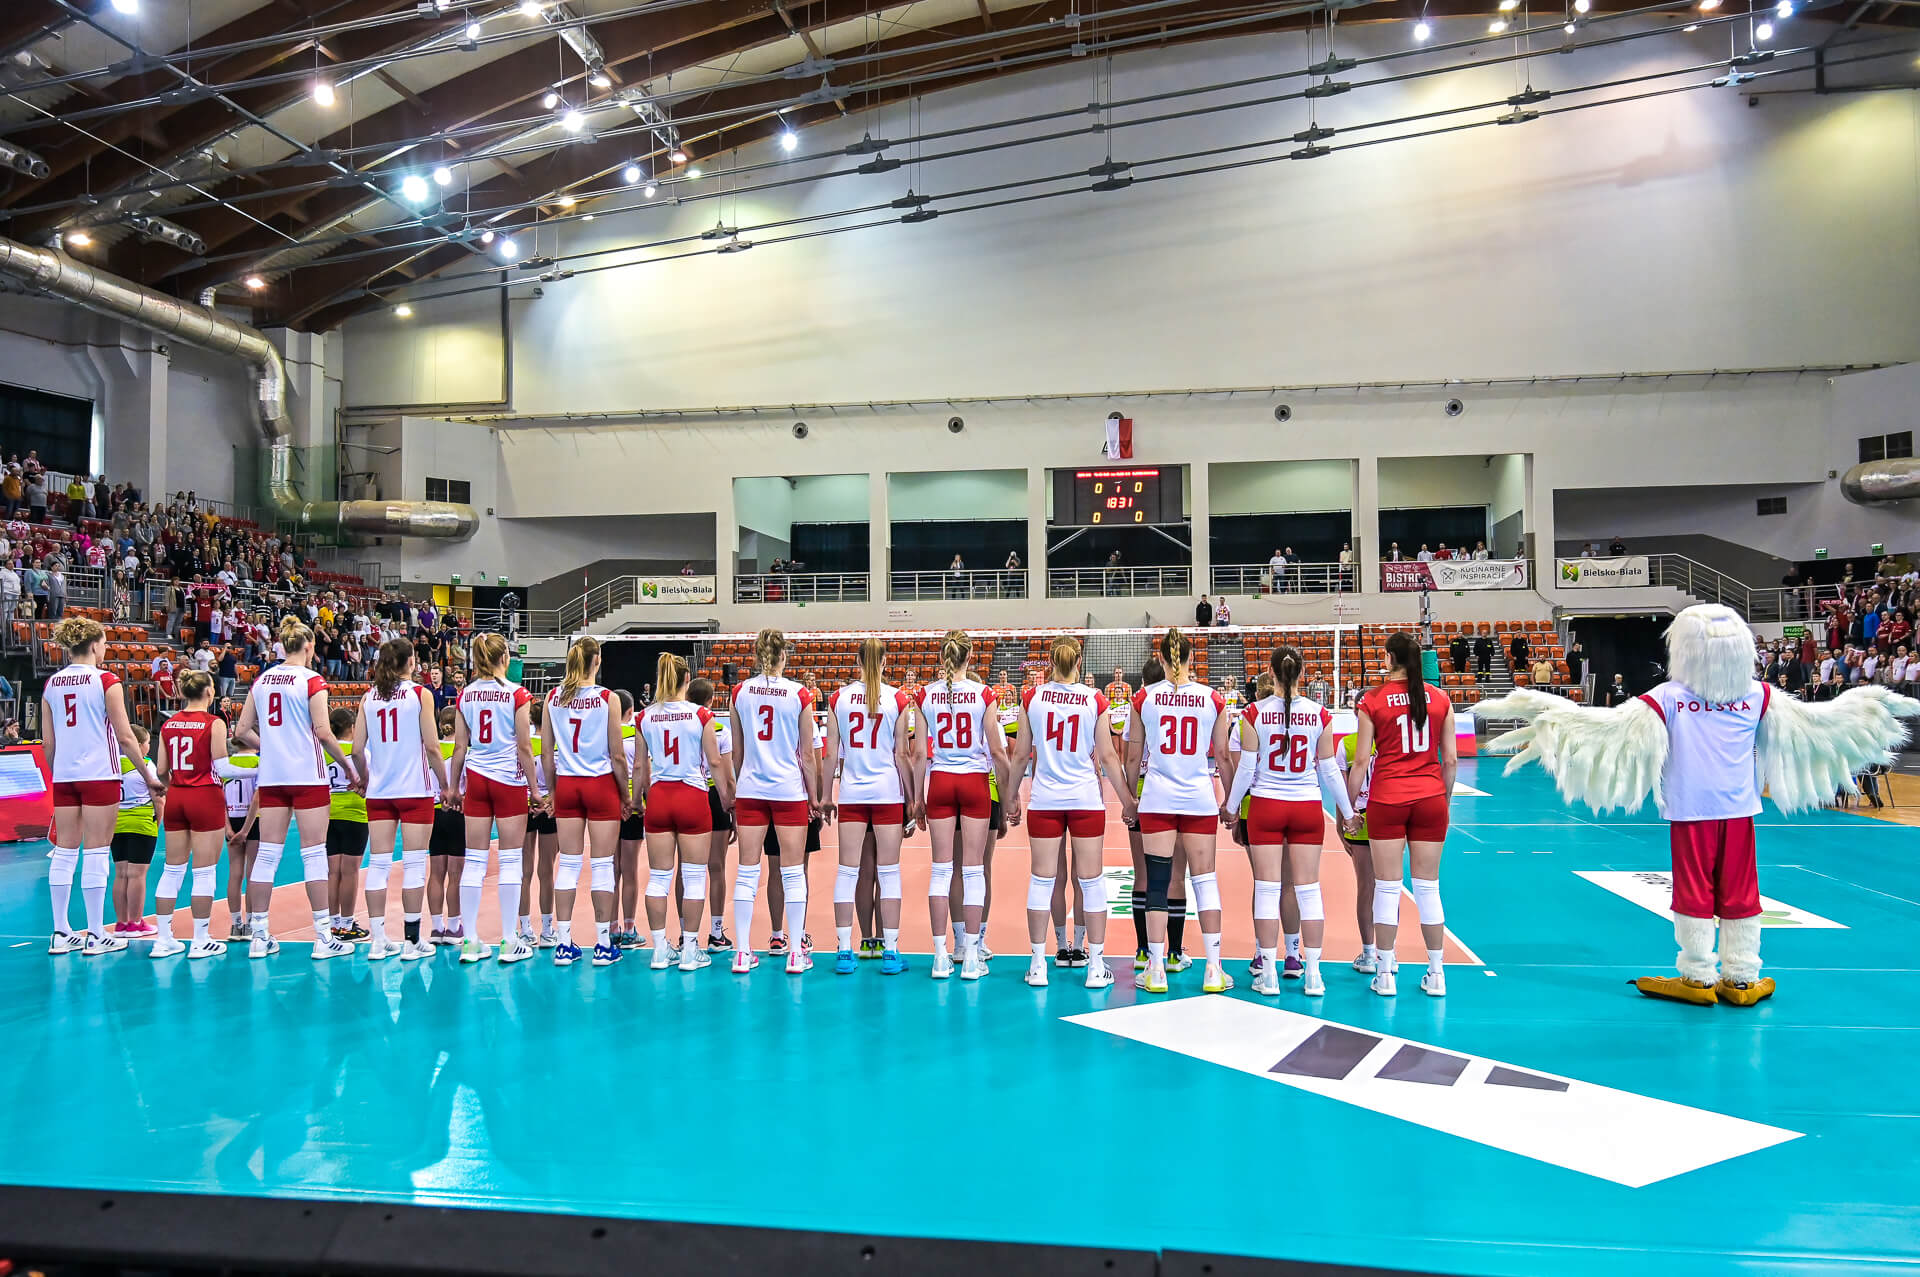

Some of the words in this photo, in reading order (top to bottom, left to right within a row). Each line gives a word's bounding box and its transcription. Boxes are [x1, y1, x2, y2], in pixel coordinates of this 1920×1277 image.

[1094, 483, 1102, 494] 0
[1134, 482, 1142, 493] 0
[1092, 512, 1101, 523] 0
[1135, 511, 1143, 522] 0
[1460, 565, 1506, 573] KULINARNE
[1460, 572, 1506, 580] INSPIRACJE
[1583, 568, 1642, 577] Bielsko-Biała
[661, 586, 713, 594] Bielsko-Biała
[51, 674, 92, 687] KORNELUK
[261, 674, 297, 686] STYSIAK
[464, 690, 511, 703] WITKOWSKA
[748, 685, 788, 698] ALAGIERSKA
[1041, 690, 1089, 707] MĘDRZYK
[1155, 691, 1205, 708] RÓŻAŃSKI
[64, 693, 77, 728] 5
[268, 692, 283, 727] 9
[1677, 700, 1751, 713] POLSKA
[376, 707, 398, 742] 11
[650, 712, 693, 723] KOWALEWSKA
[757, 704, 774, 742] 3
[1261, 711, 1318, 727] WENRSKA
[479, 709, 493, 744] 6
[848, 711, 884, 749] 27
[936, 712, 972, 749] 28
[1046, 711, 1080, 753] 41
[1396, 713, 1430, 754] 10
[569, 718, 582, 753] 7
[1160, 715, 1198, 756] 30
[169, 735, 194, 770] 12
[663, 729, 680, 765] 4
[1268, 733, 1308, 773] 26
